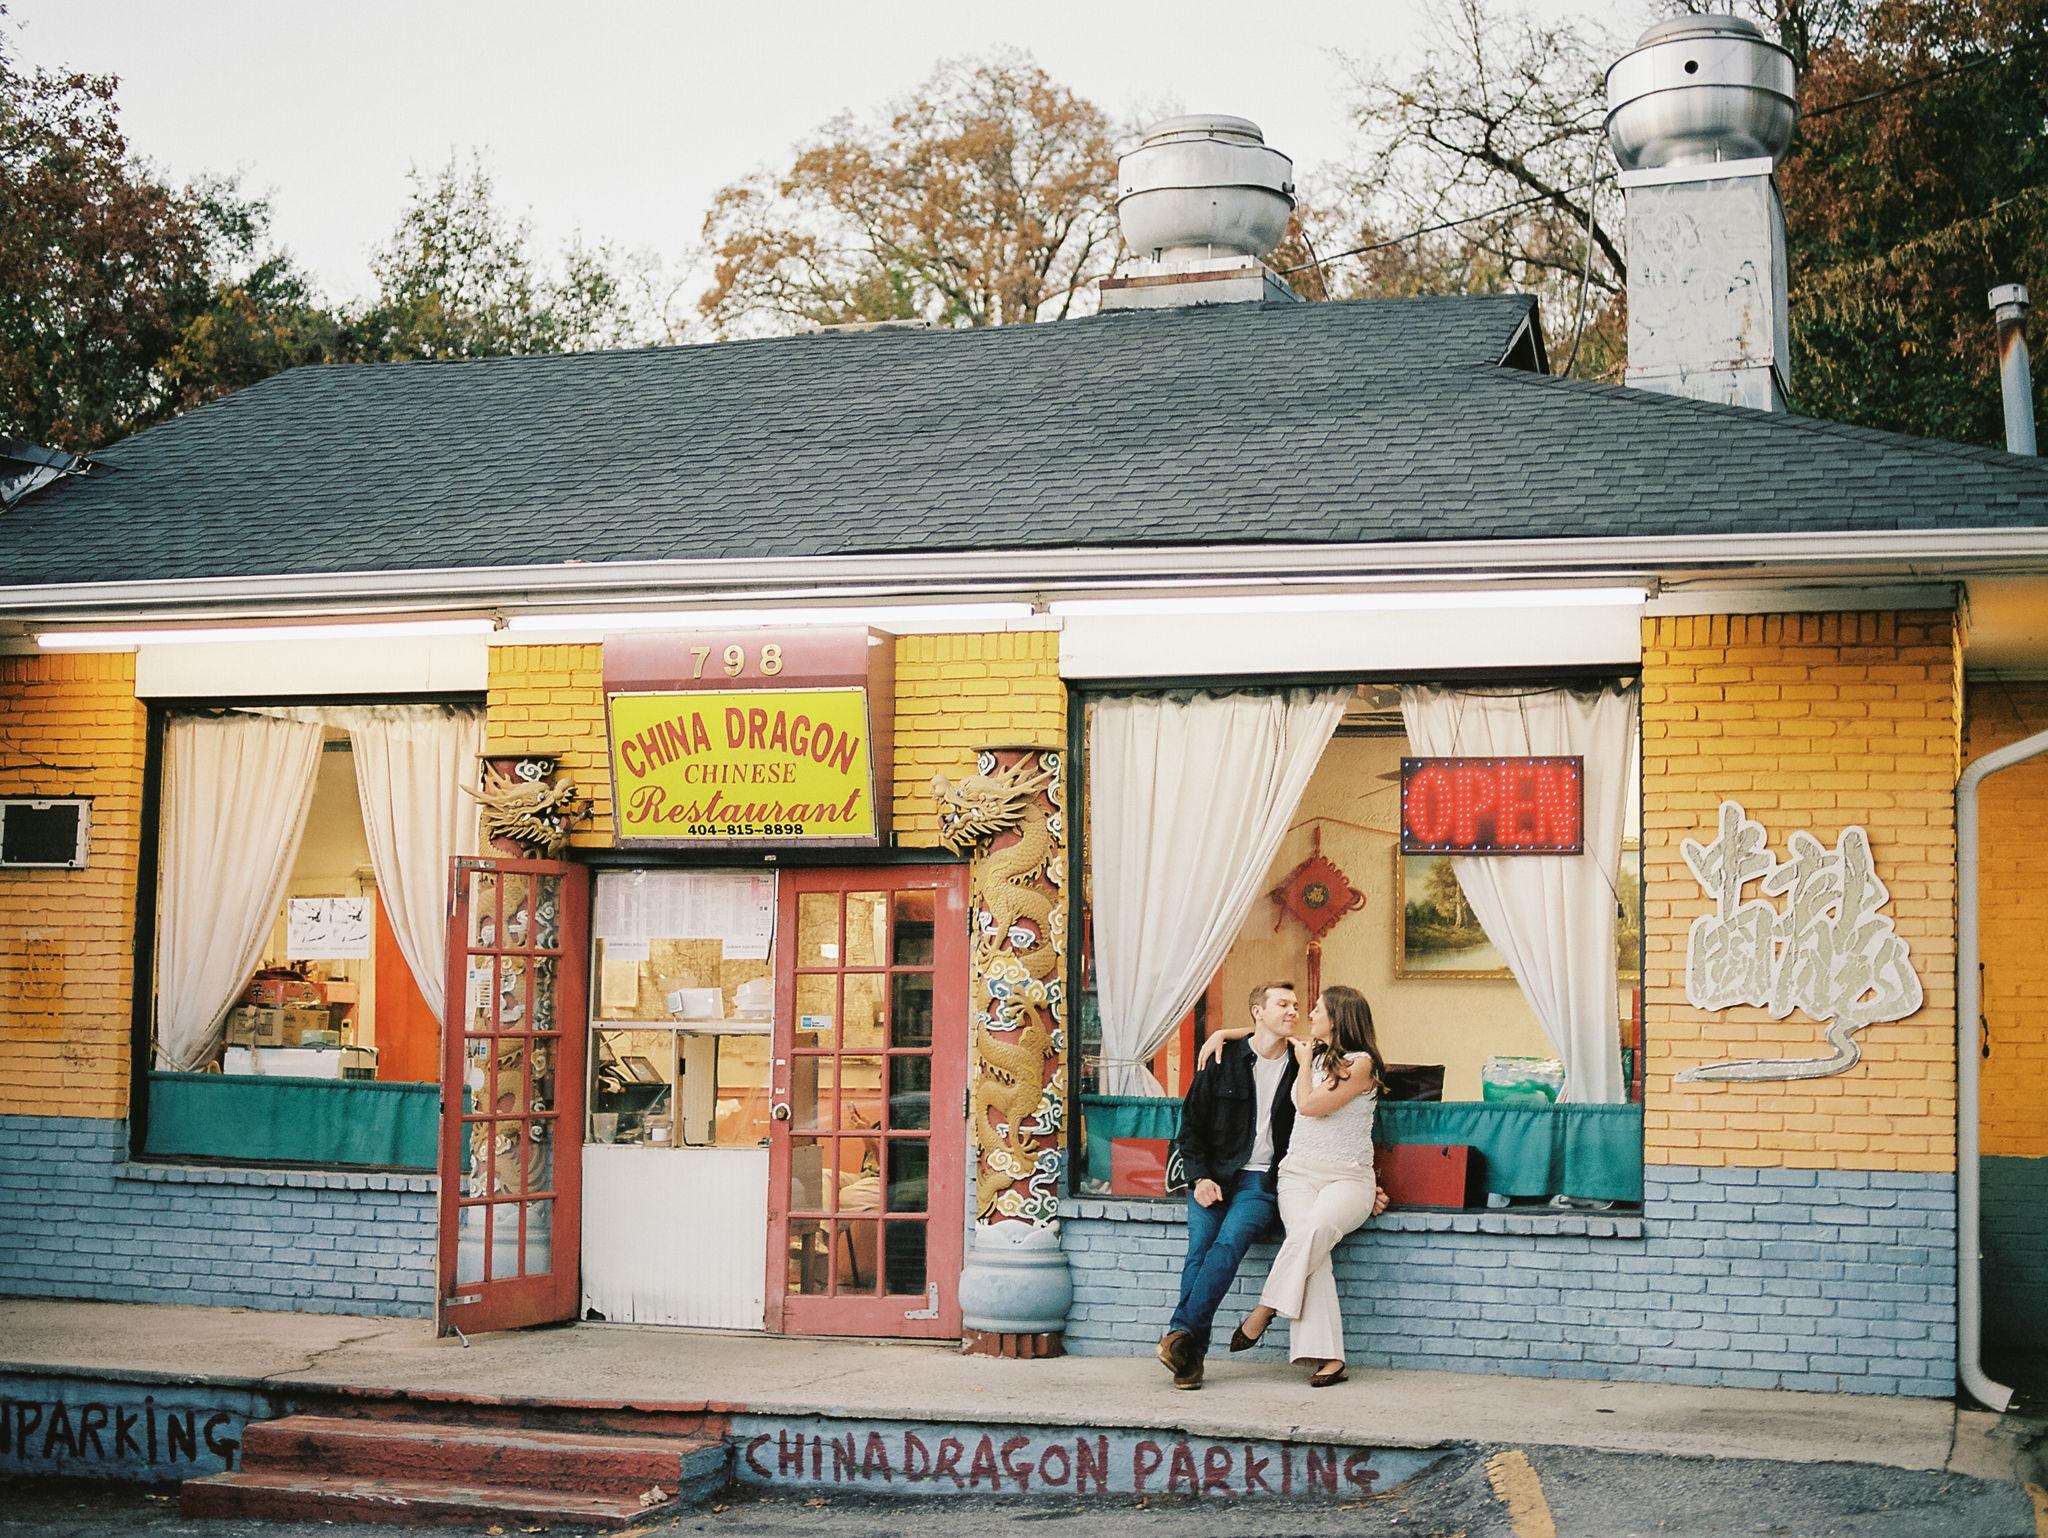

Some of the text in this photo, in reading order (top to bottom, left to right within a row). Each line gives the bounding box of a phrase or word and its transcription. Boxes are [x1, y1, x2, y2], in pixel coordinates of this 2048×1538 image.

[689, 643, 784, 680] 798
[621, 706, 860, 779] CHINA DRAGON
[684, 761, 798, 785] CHINESE
[626, 785, 862, 824] Restaurant
[1408, 768, 1574, 844] OPEN
[687, 823, 804, 836] 404-815-8898
